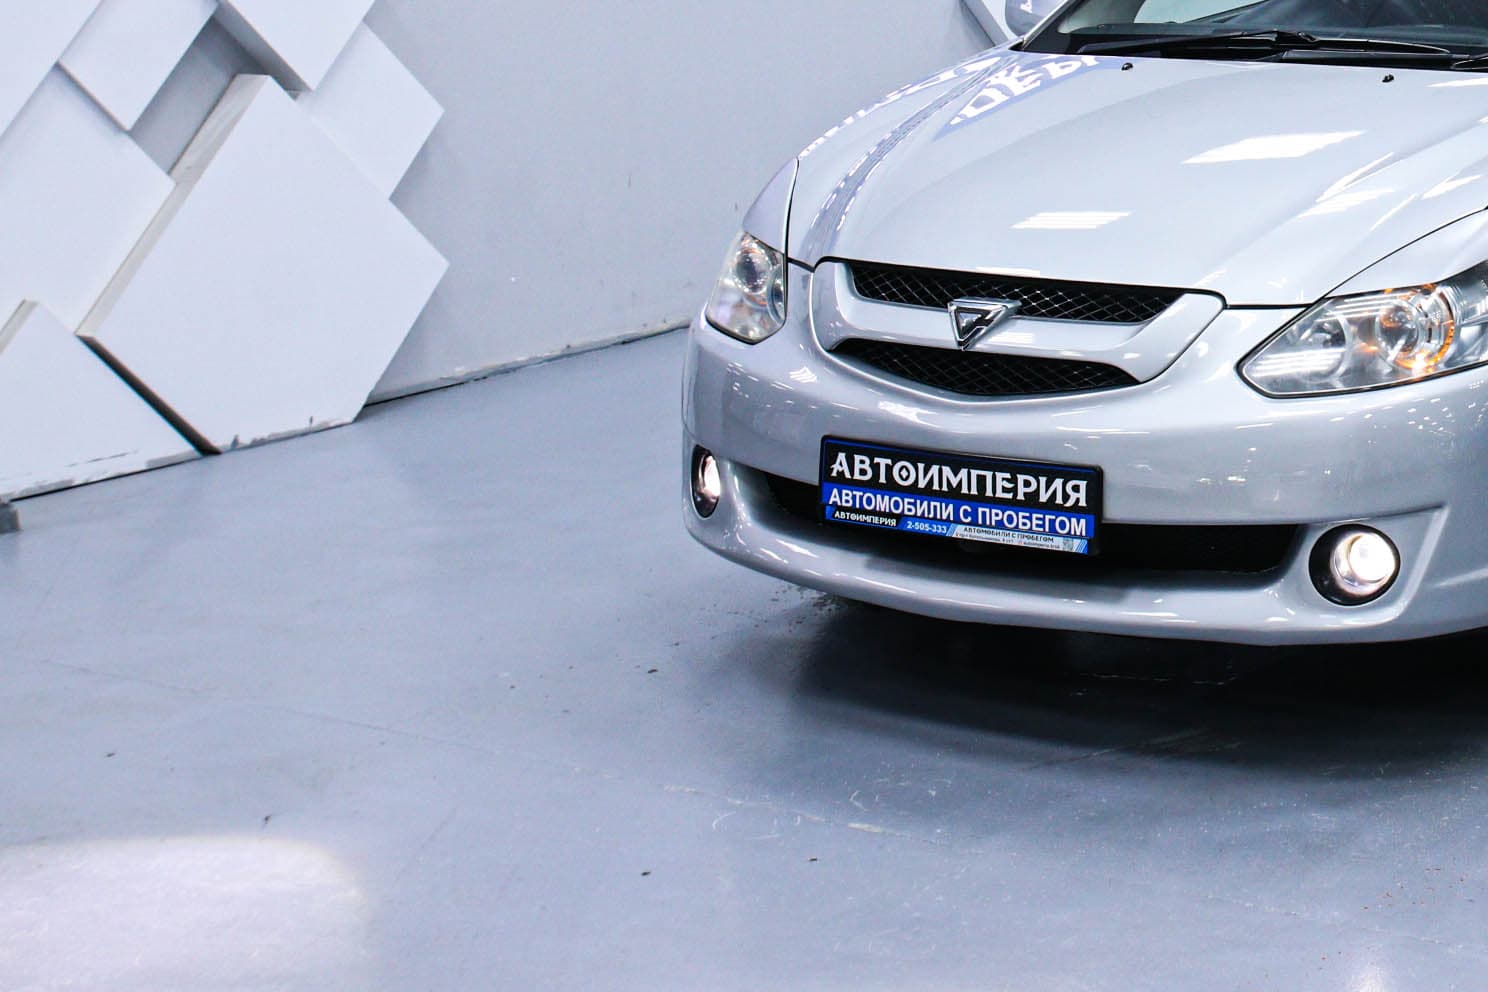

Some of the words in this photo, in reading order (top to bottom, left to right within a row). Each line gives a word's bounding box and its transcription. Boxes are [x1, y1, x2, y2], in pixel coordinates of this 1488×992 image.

[830, 452, 1087, 507] АВТОИМПЕРИЯ
[829, 488, 954, 521] АВТОМОБИЛИ
[960, 505, 972, 523] С
[978, 507, 1087, 536] ПРОБЕГОМ
[834, 510, 897, 527] АВТОИМПЕРИЯ
[906, 521, 947, 534] 2-505-333
